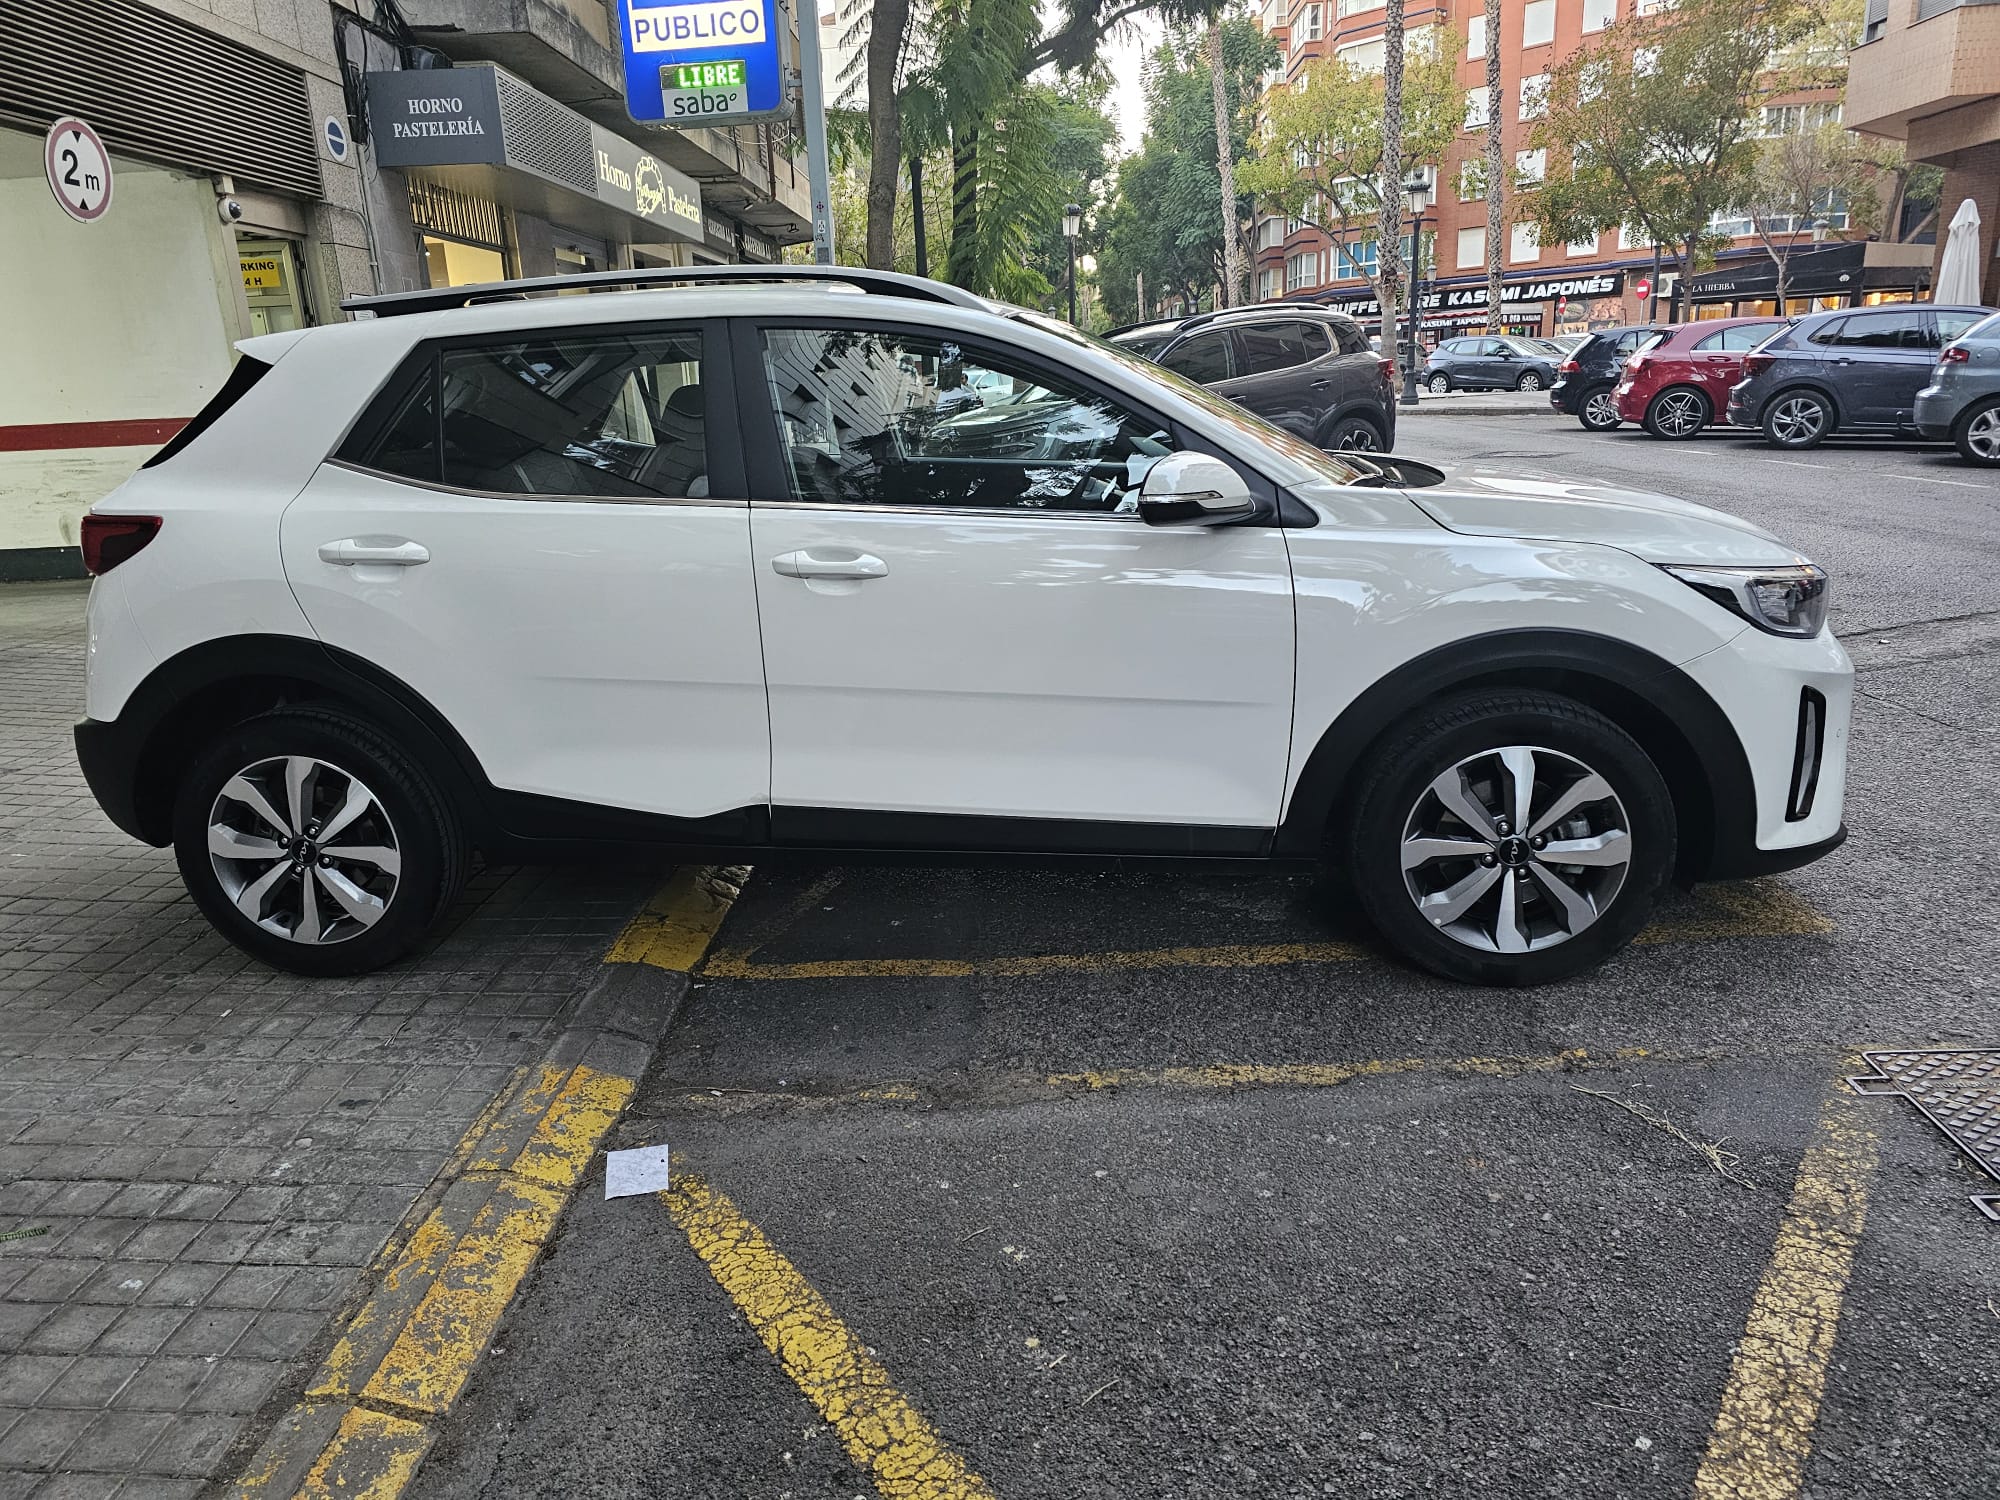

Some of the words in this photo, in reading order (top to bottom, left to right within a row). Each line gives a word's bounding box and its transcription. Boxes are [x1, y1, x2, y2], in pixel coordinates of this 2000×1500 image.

[634, 9, 760, 43] PUBLICO
[678, 63, 740, 87] LIBRE
[407, 97, 463, 115] HORNO
[392, 116, 485, 138] PASTELERÍA
[62, 149, 80, 187] 2
[85, 173, 100, 191] m
[598, 149, 632, 192] Horno
[240, 261, 275, 271] RKING
[254, 277, 262, 286] H
[1704, 282, 1735, 292] HIERBA
[1328, 300, 1382, 315] BUFFE
[1522, 275, 1615, 299] JAPONÉS
[1421, 320, 1452, 328] KASUMI
